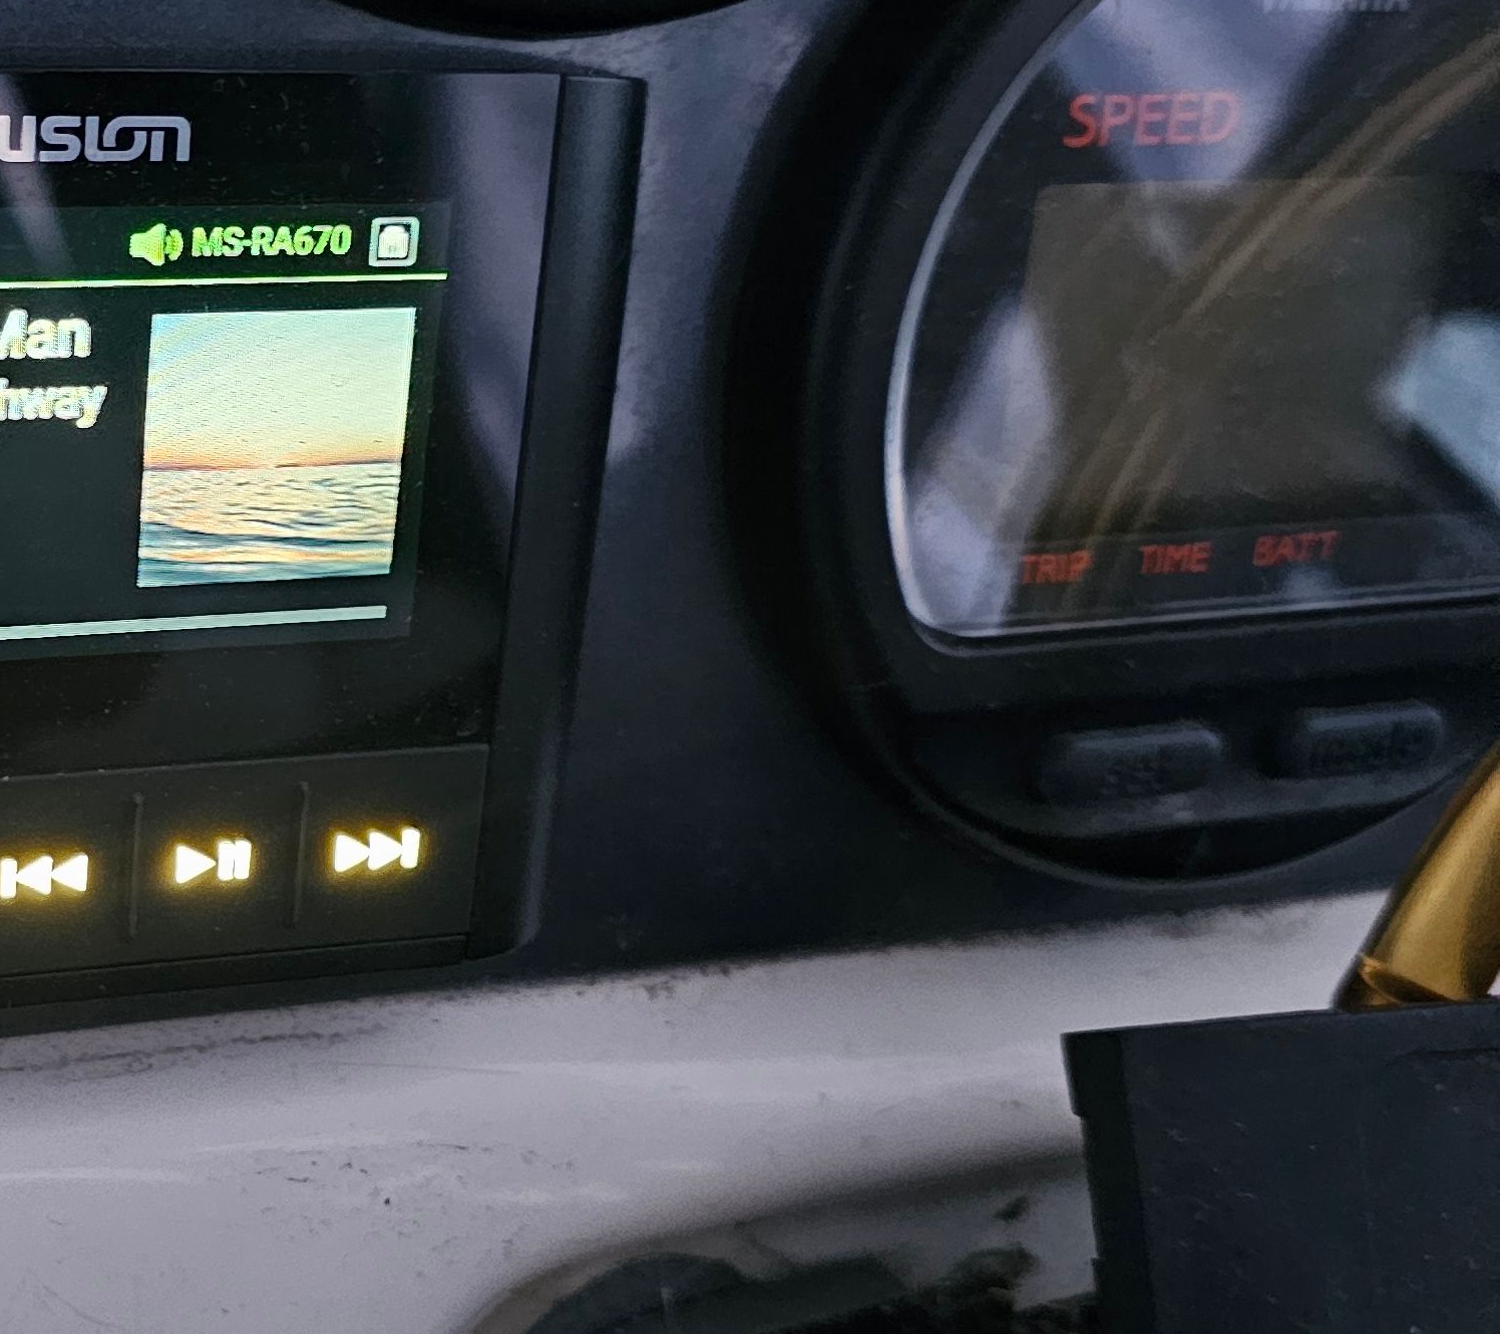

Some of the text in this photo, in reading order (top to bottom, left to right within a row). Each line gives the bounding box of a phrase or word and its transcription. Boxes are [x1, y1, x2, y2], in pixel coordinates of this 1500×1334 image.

[1061, 90, 1242, 149] SPEED
[192, 224, 351, 257] MS-RA670
[1140, 541, 1212, 574] TIME
[1252, 530, 1339, 568] BATT
[1021, 550, 1092, 584] TRIP
